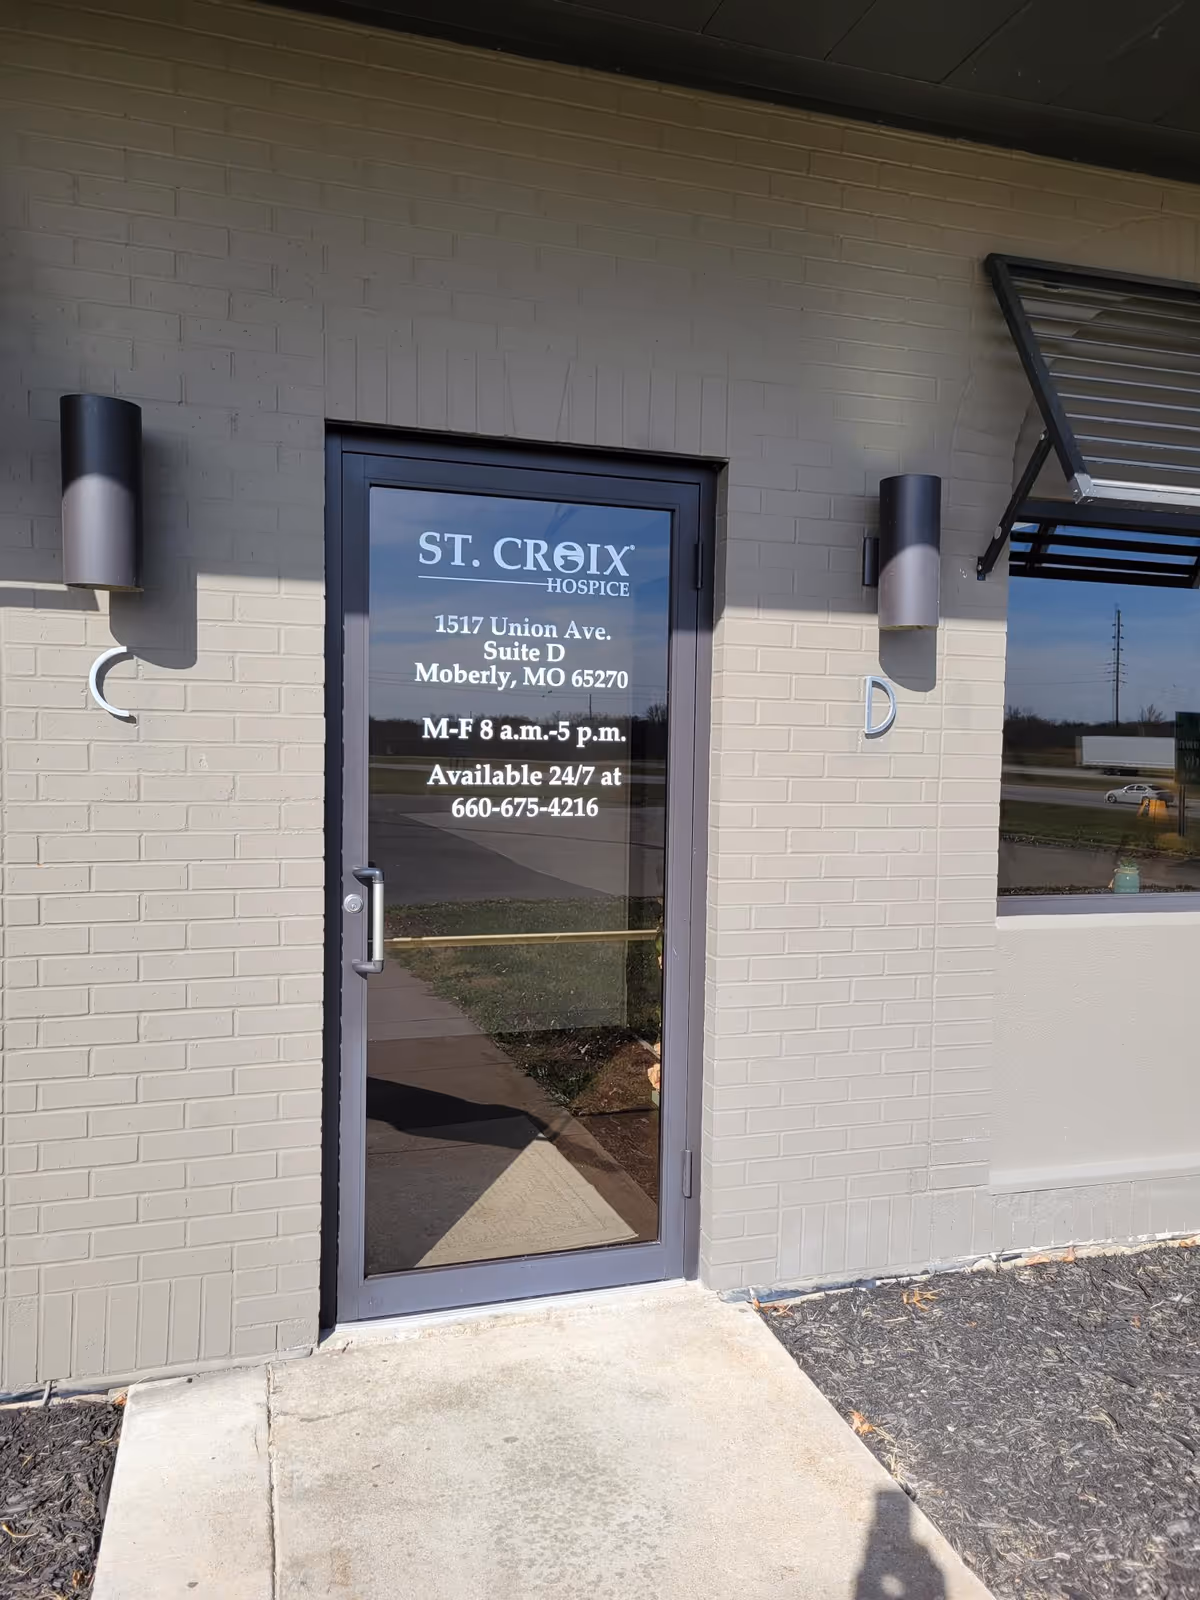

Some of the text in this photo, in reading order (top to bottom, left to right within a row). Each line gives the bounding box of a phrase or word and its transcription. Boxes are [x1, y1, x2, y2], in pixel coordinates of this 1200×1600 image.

[418, 531, 480, 567] ST.
[546, 578, 630, 597] HOSPICE
[434, 614, 612, 641] 1517 Union Ave.
[483, 640, 566, 662] Suite D
[89, 646, 130, 717] C
[414, 662, 629, 691] Moberly, MO 65270
[865, 675, 896, 734] D
[421, 717, 627, 748] M-F 8 a.m.-5 p.m.
[426, 764, 622, 787] Available 24/7 at
[451, 797, 599, 818] 660-675-4216
